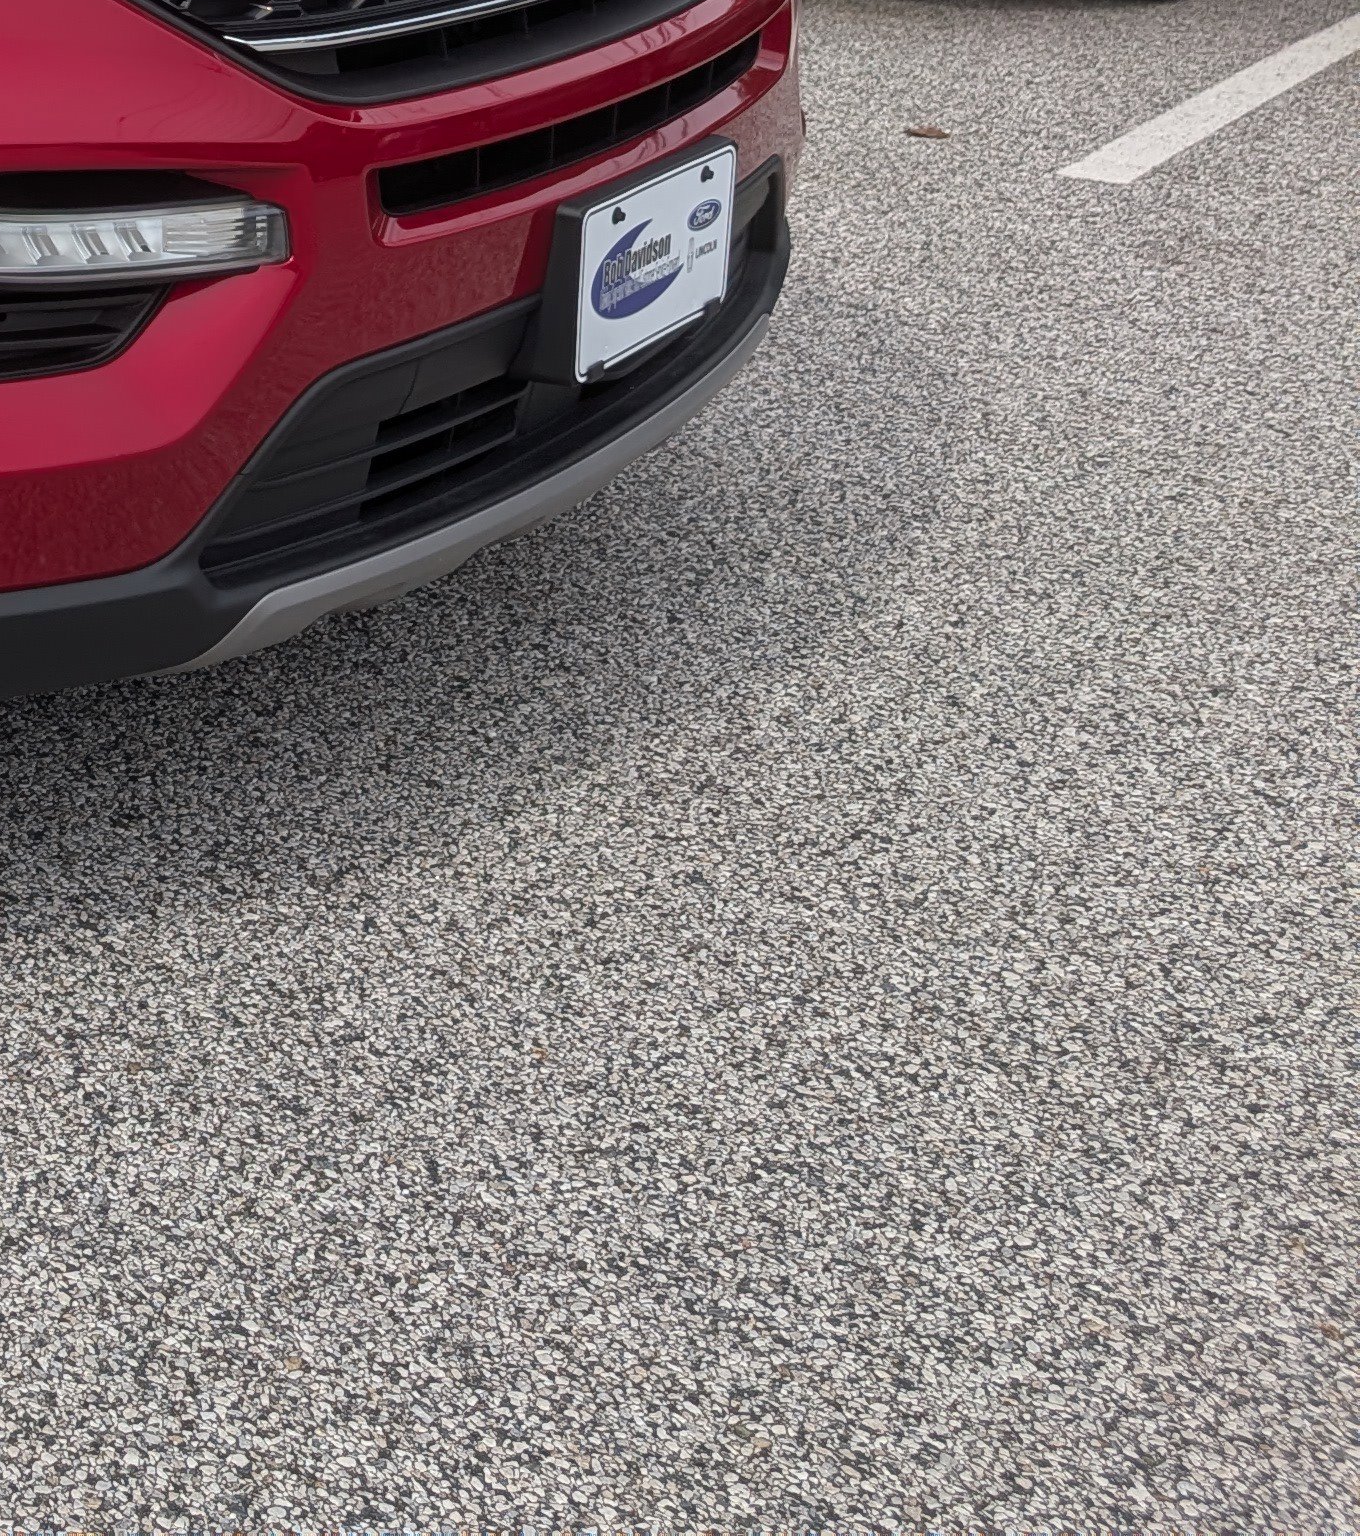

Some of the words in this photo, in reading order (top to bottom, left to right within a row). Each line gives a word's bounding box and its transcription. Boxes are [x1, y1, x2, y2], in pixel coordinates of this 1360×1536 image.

[693, 204, 716, 226] Ford
[695, 239, 718, 259] LINCOLN
[603, 251, 625, 288] Bob
[625, 233, 672, 277] Davidson
